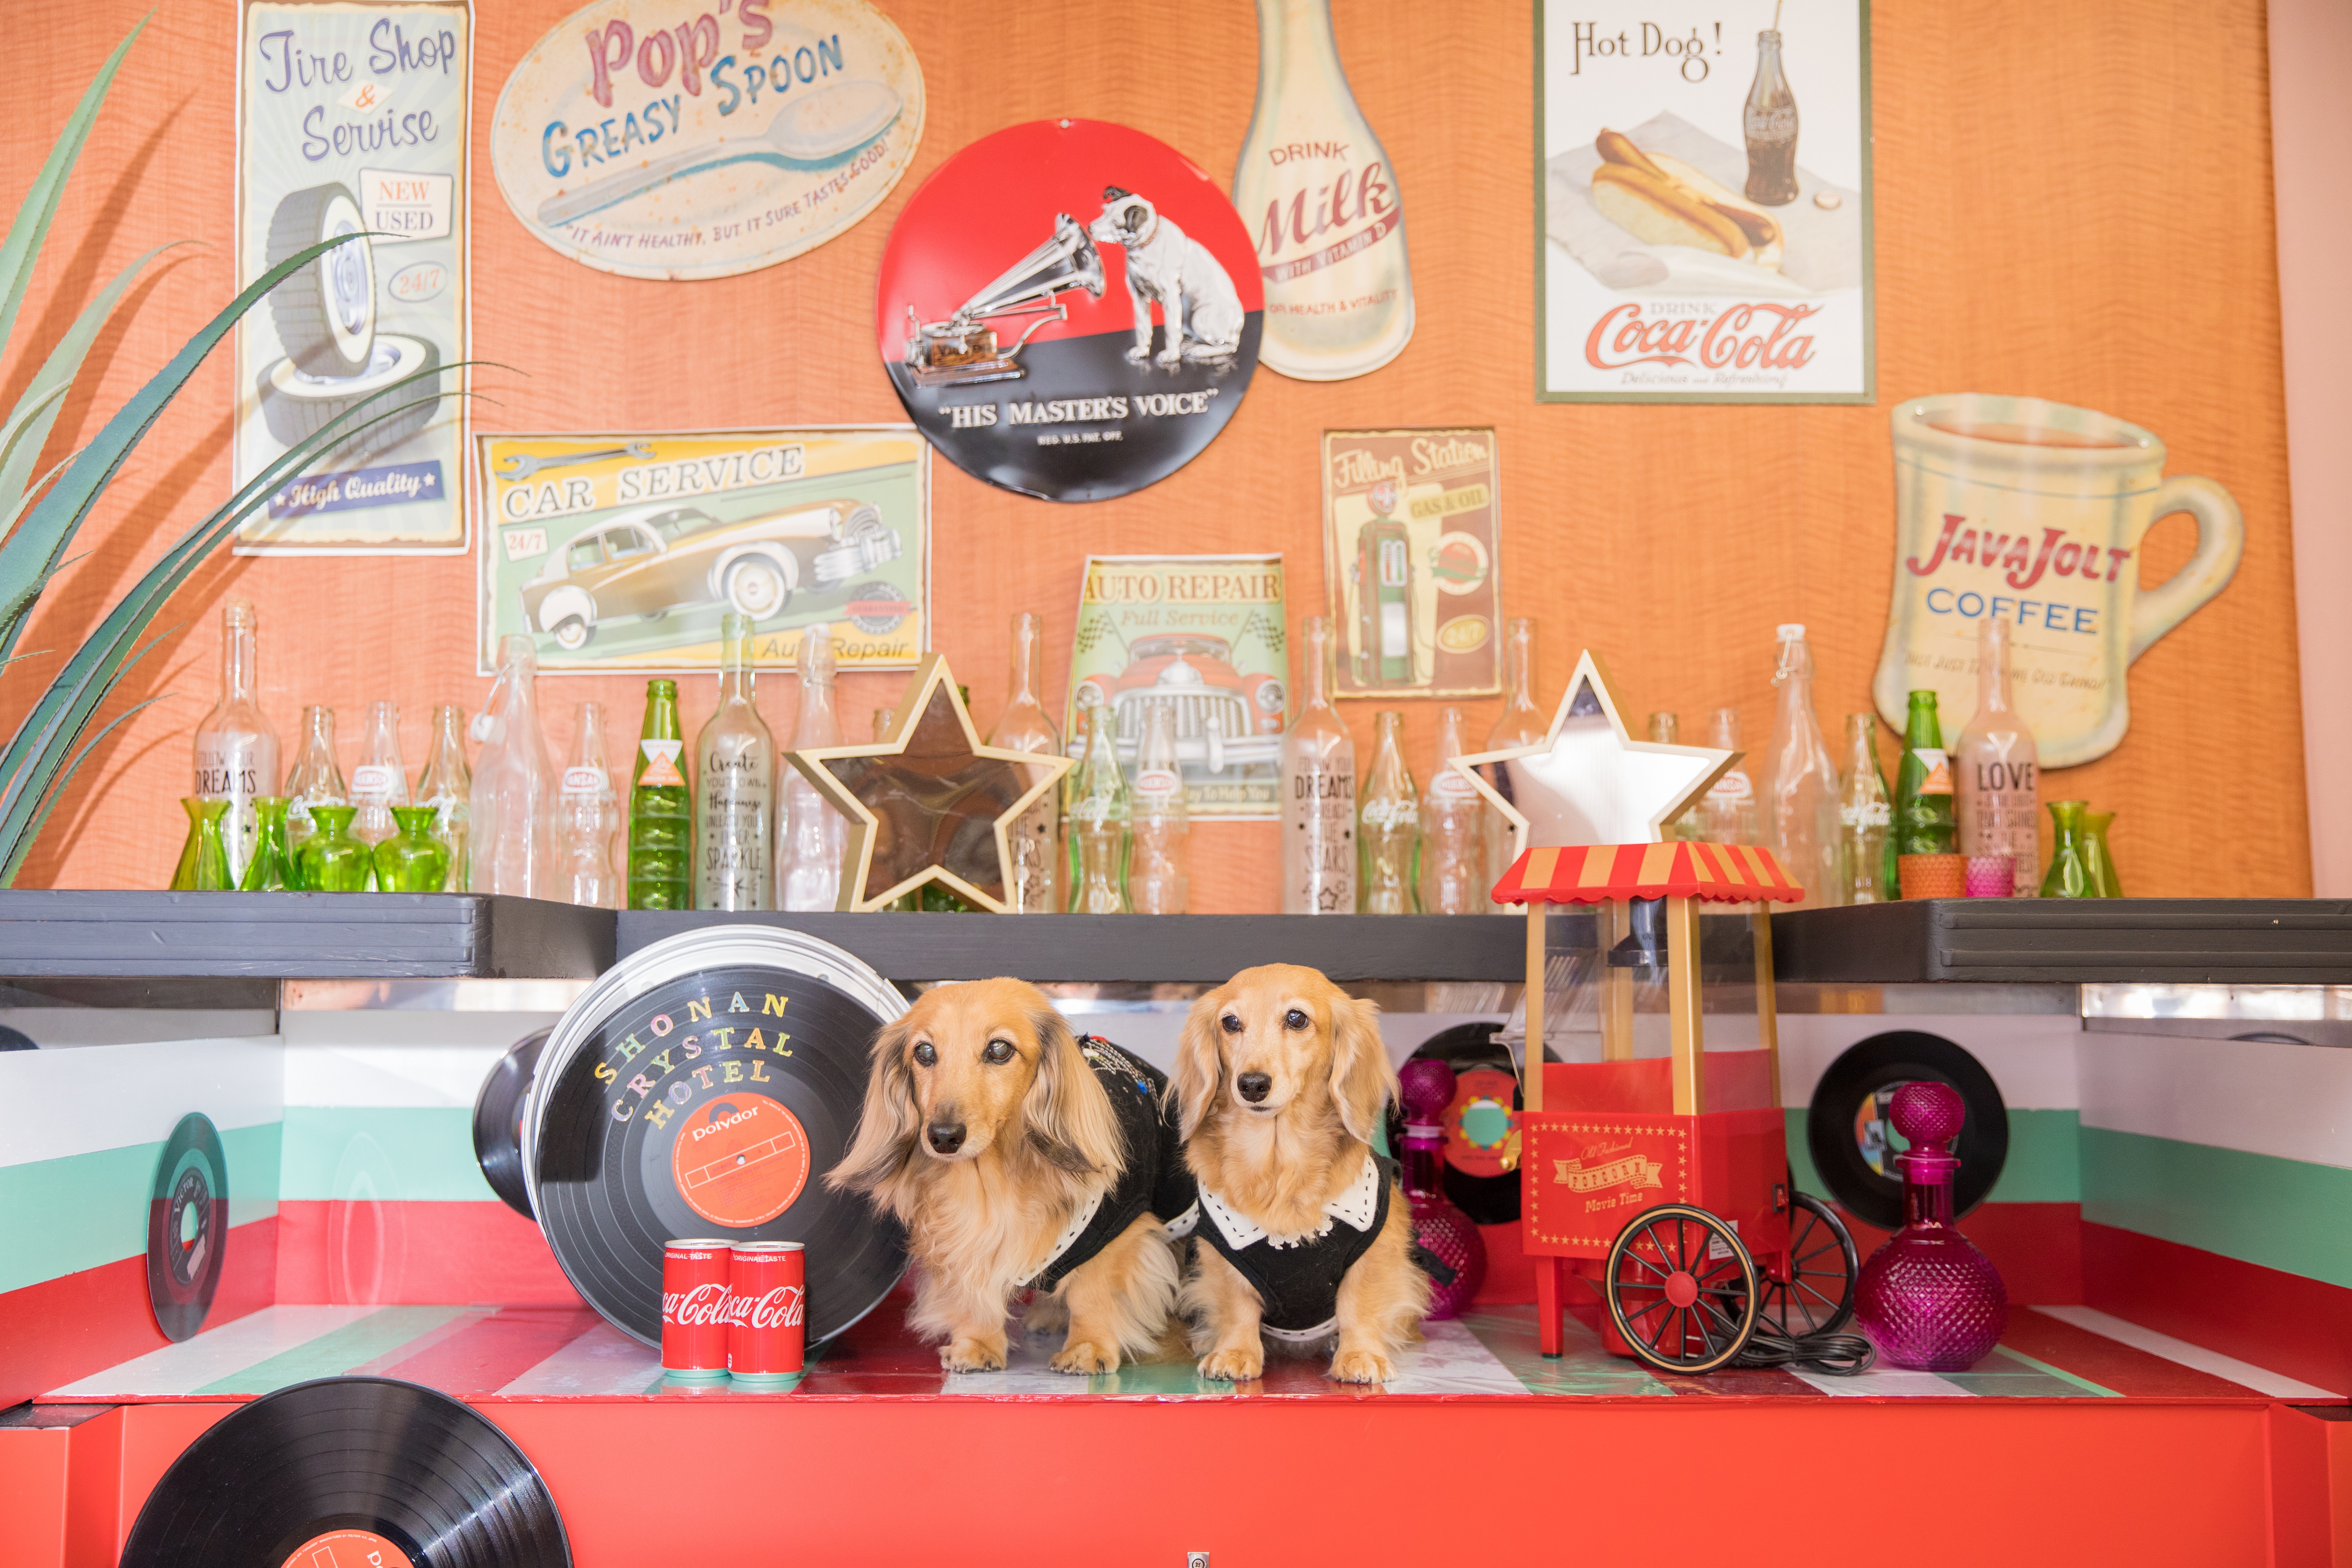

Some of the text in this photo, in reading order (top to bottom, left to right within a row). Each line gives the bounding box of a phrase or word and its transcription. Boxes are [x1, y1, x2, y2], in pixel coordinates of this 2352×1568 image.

[260, 18, 455, 92] Tire Shop
[1569, 21, 1631, 76] Hot
[355, 84, 375, 108] &
[542, 34, 843, 178] GREASY SPOON
[302, 105, 438, 161] Servise
[1269, 142, 1350, 166] DRINK
[379, 181, 430, 201] NEW
[713, 224, 740, 241] BUT
[748, 217, 761, 232] IT
[765, 201, 801, 226] SURE
[803, 173, 849, 208] TASTES
[375, 210, 433, 231] USED
[1257, 162, 1395, 256] Milk
[1276, 221, 1387, 282] WITH VITAMIN D
[399, 269, 440, 295] 24/7
[1269, 288, 1397, 315] OR HEALTH & VITALITY
[1651, 302, 1717, 315] DRINK
[1585, 303, 1825, 370] Coca-Cola
[1008, 396, 1128, 425] MASTER'S
[506, 447, 802, 518] CAR SERVICE
[1333, 437, 1488, 497] Filling Station
[289, 471, 422, 510] High Quality
[1411, 489, 1484, 517] GAS & OIL
[508, 533, 542, 550] 24/7
[1084, 573, 1279, 600] AUTO REPAIR
[1121, 610, 1239, 627] Full Service
[1926, 588, 2100, 636] COFFEE
[833, 637, 909, 661] Repair
[710, 750, 758, 773] Create
[1977, 762, 2035, 791] LOVE
[594, 991, 789, 1085] SHONAN
[611, 1027, 793, 1122] CRYSTAL
[644, 1059, 770, 1130] HOTEL
[692, 1106, 759, 1142] polydor
[1573, 1161, 1641, 1187] POPCORN
[1585, 1192, 1643, 1213] Movie Time
[664, 1252, 688, 1260] ORIGINAL
[662, 1283, 732, 1325] ca-Cola
[729, 1284, 805, 1329] ca-Cola
